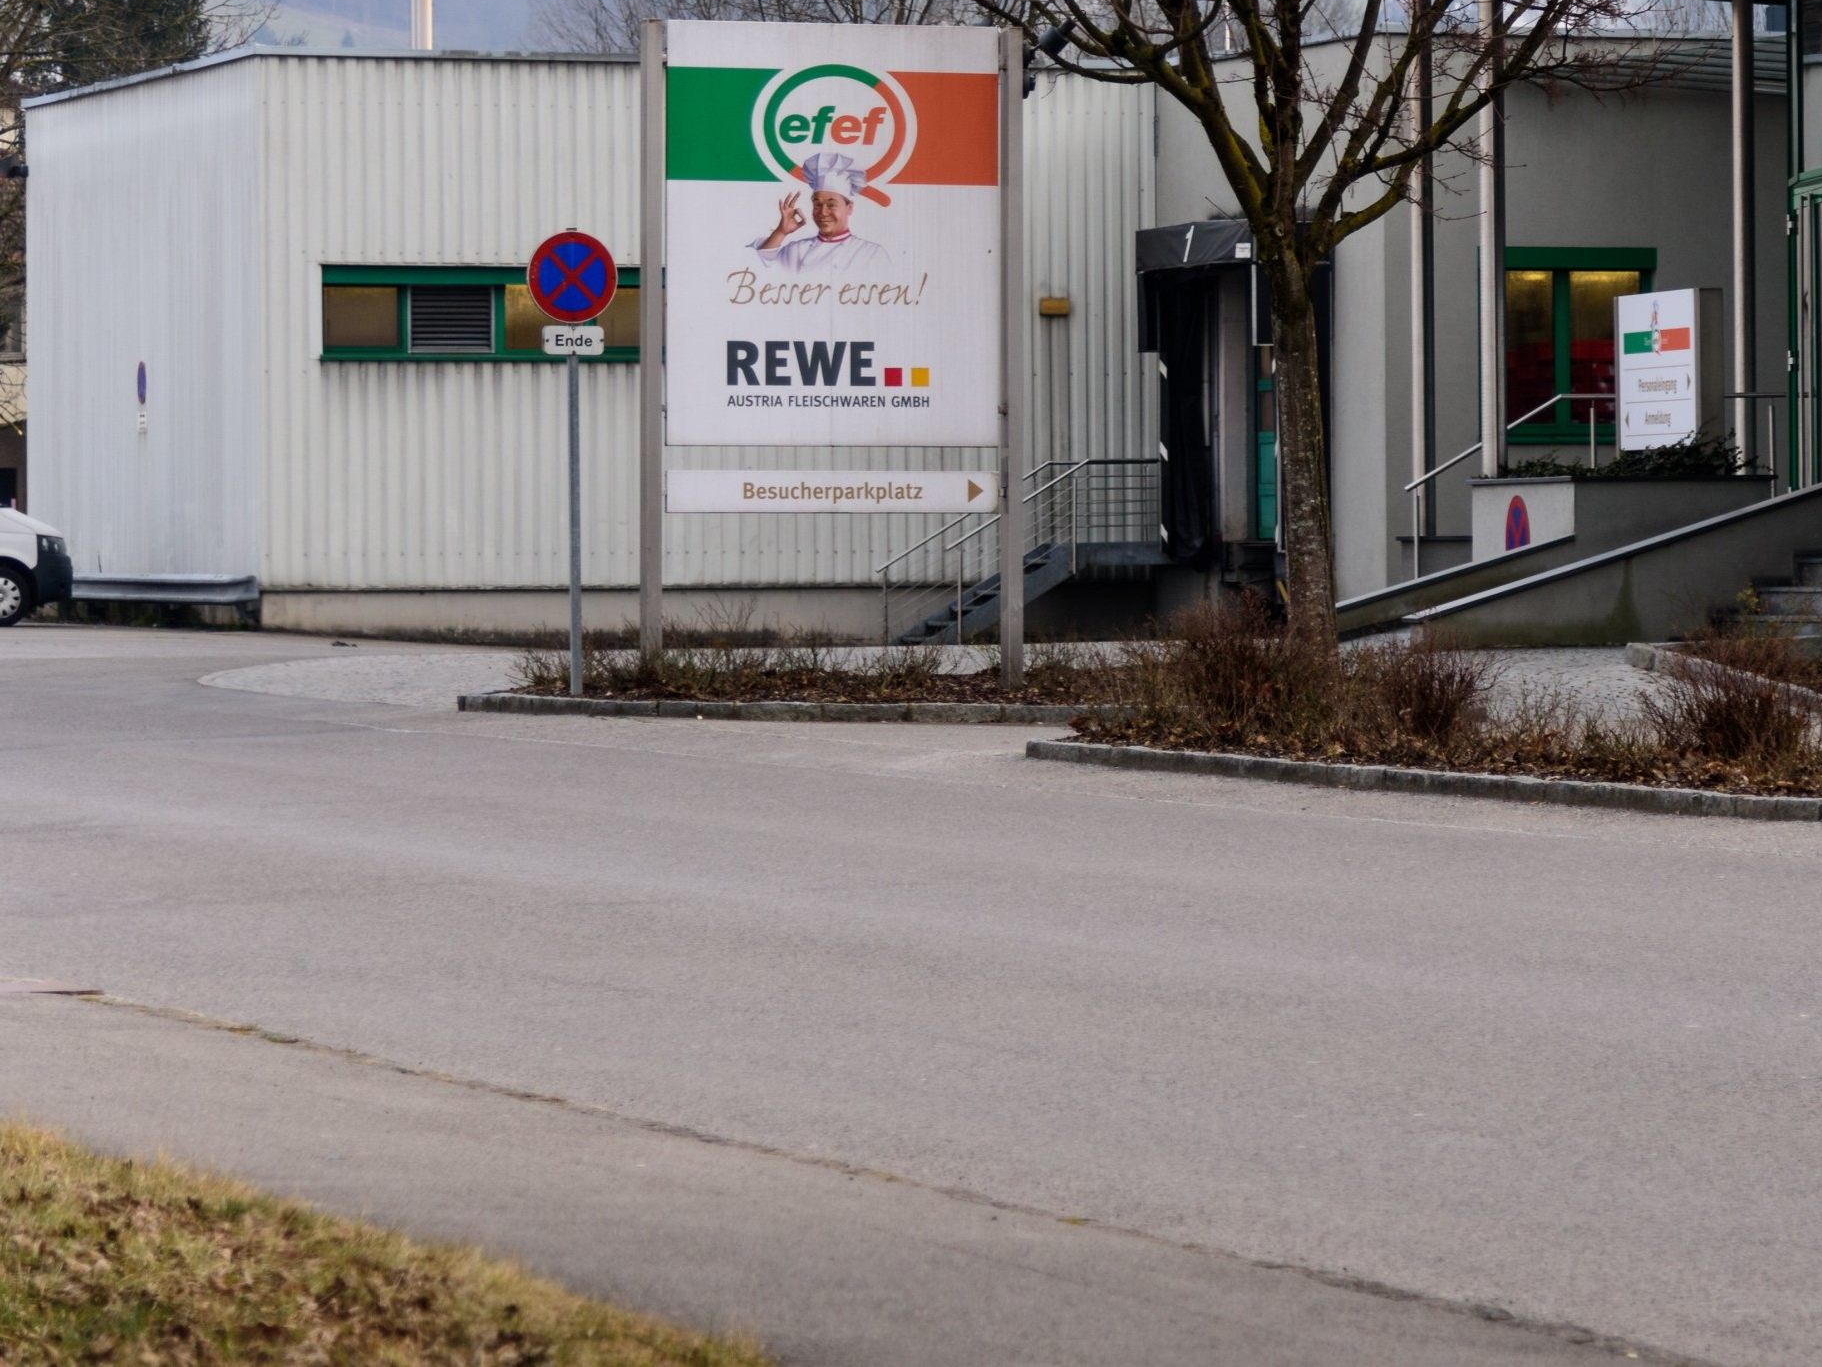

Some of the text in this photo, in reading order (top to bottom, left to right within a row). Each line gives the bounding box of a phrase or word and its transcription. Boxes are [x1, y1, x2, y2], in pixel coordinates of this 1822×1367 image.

[779, 105, 888, 145] efef
[1183, 225, 1195, 263] 1
[726, 266, 929, 307] Besser essen!
[554, 333, 593, 348] Ende
[726, 340, 877, 387] REWE
[727, 395, 931, 409] AUSTRIA FLEISCHWAREN GMBH
[742, 481, 924, 503] Besucherparkplatz
